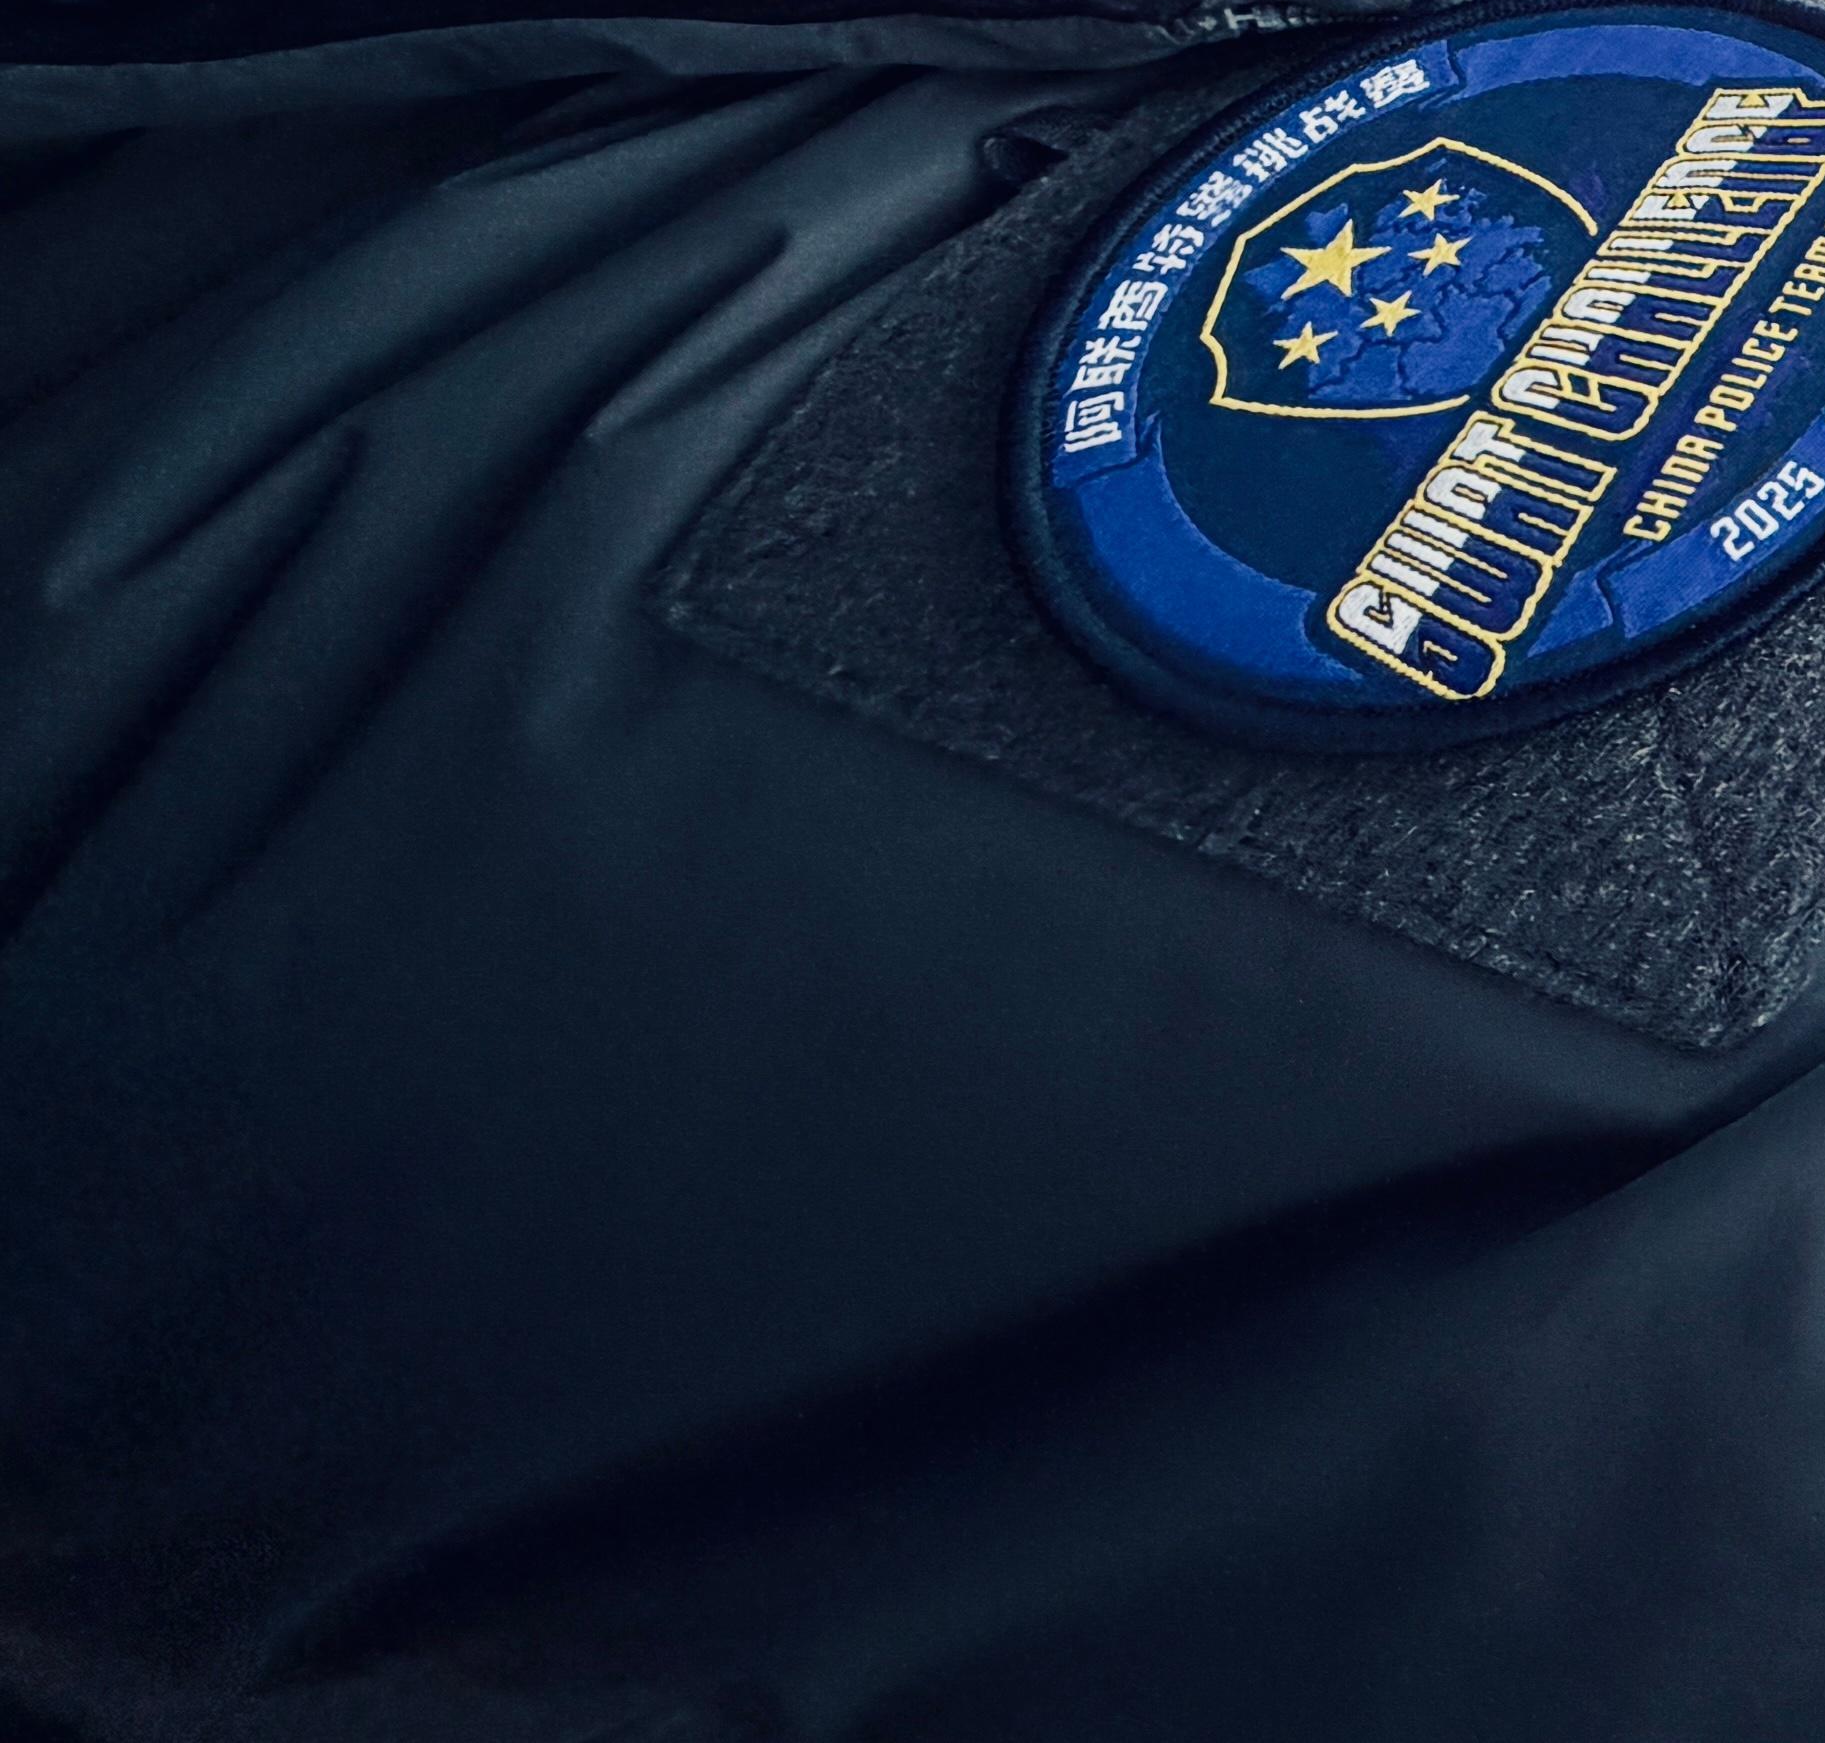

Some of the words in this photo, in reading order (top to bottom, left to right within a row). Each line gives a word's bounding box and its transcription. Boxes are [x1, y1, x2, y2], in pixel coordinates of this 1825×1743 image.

[1326, 409, 1618, 701] SWAT
[1622, 433, 1725, 543] CHINA
[1693, 319, 1799, 433] POLICE
